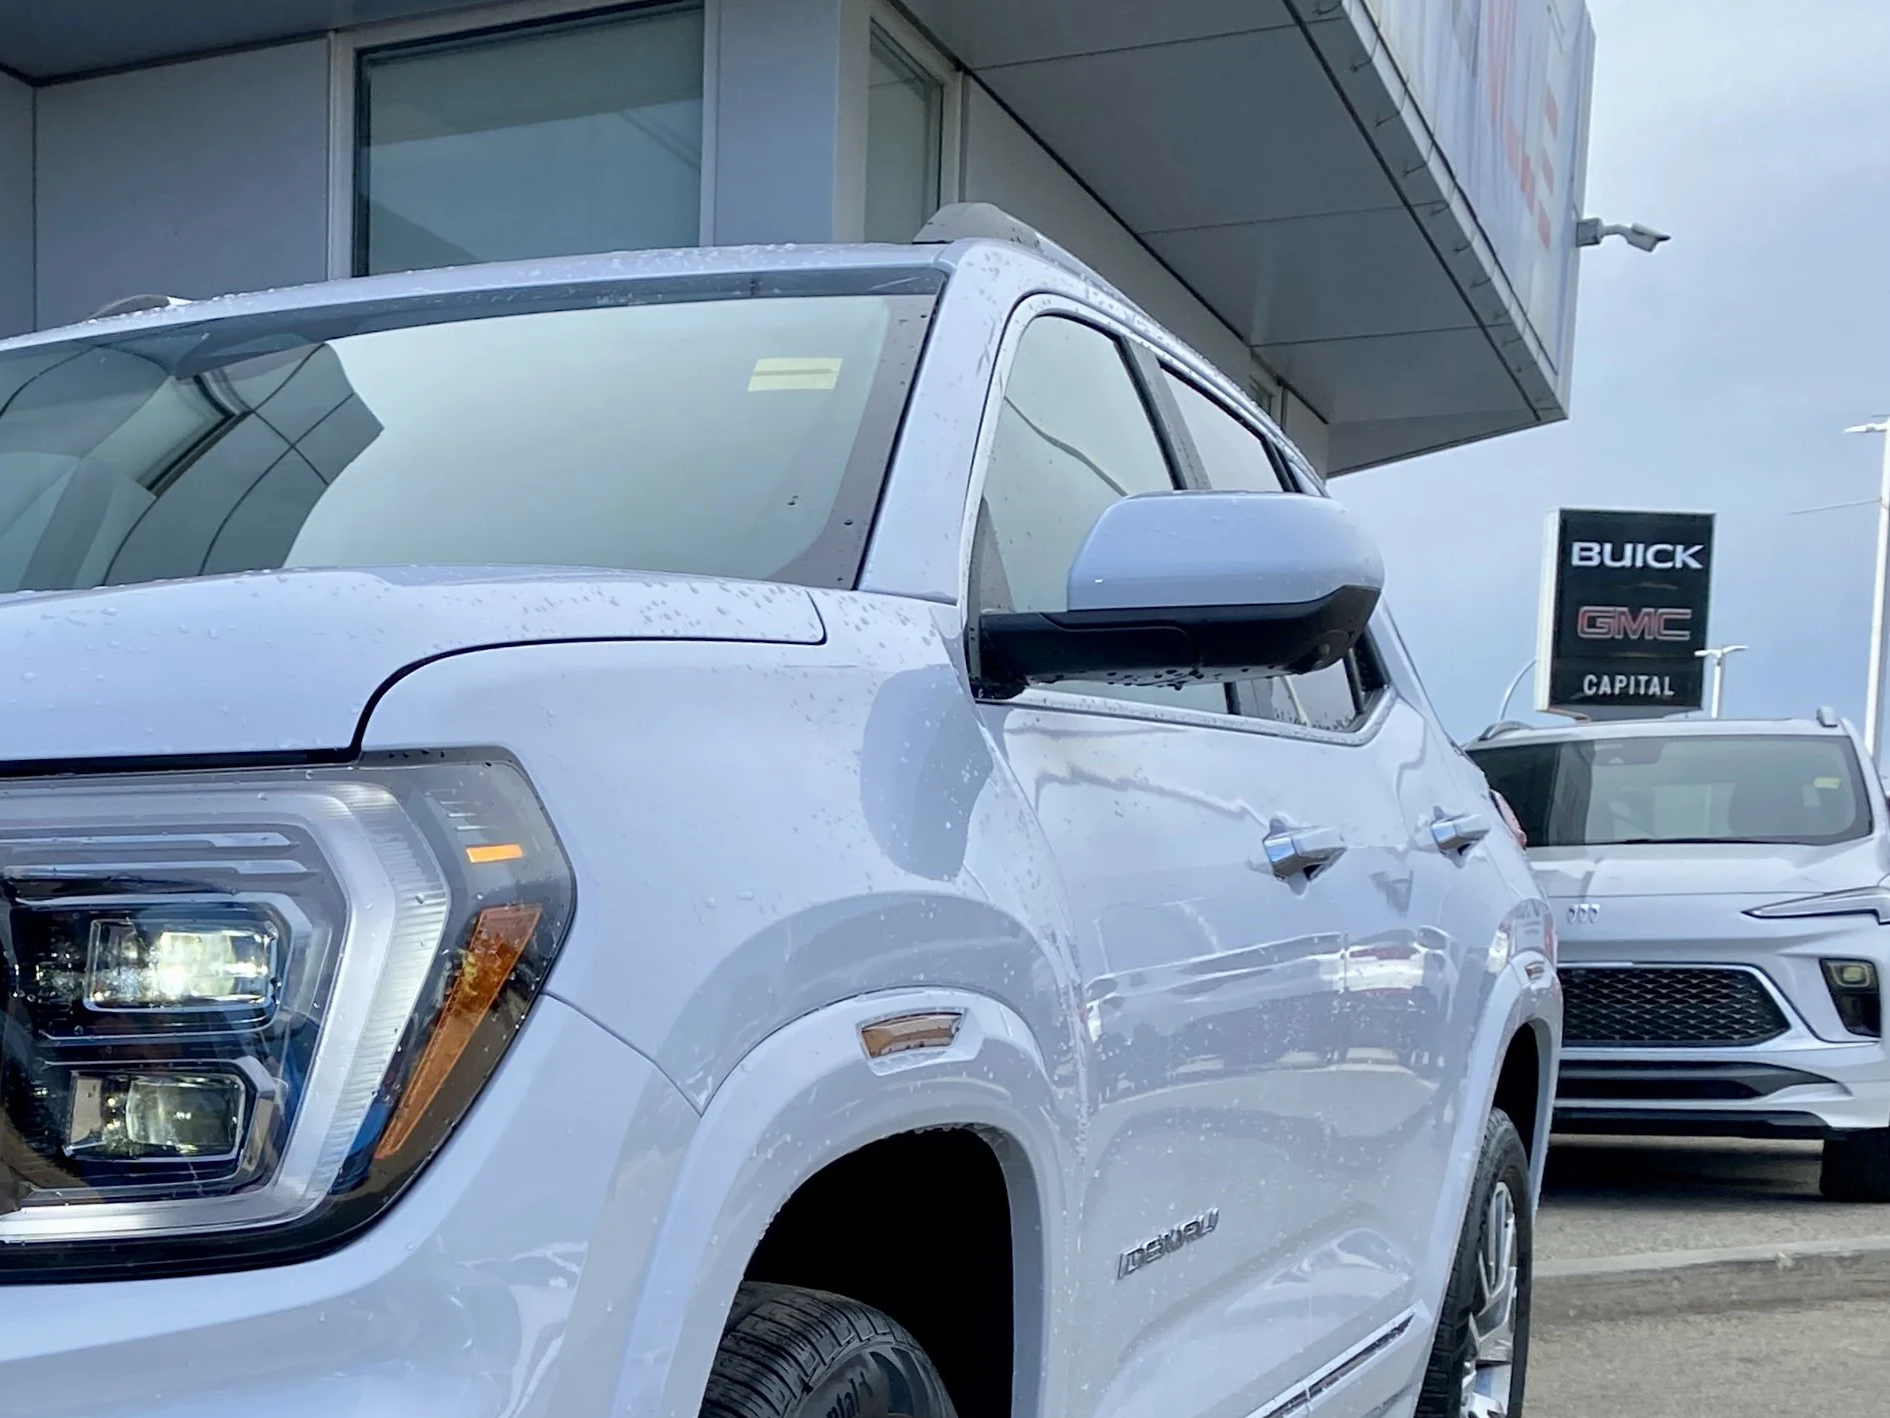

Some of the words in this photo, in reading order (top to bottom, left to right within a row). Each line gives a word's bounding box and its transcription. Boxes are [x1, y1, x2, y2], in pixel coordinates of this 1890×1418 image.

[1571, 541, 1704, 569] BUICK
[1577, 606, 1692, 641] GMC
[1583, 674, 1675, 697] CAPITAL
